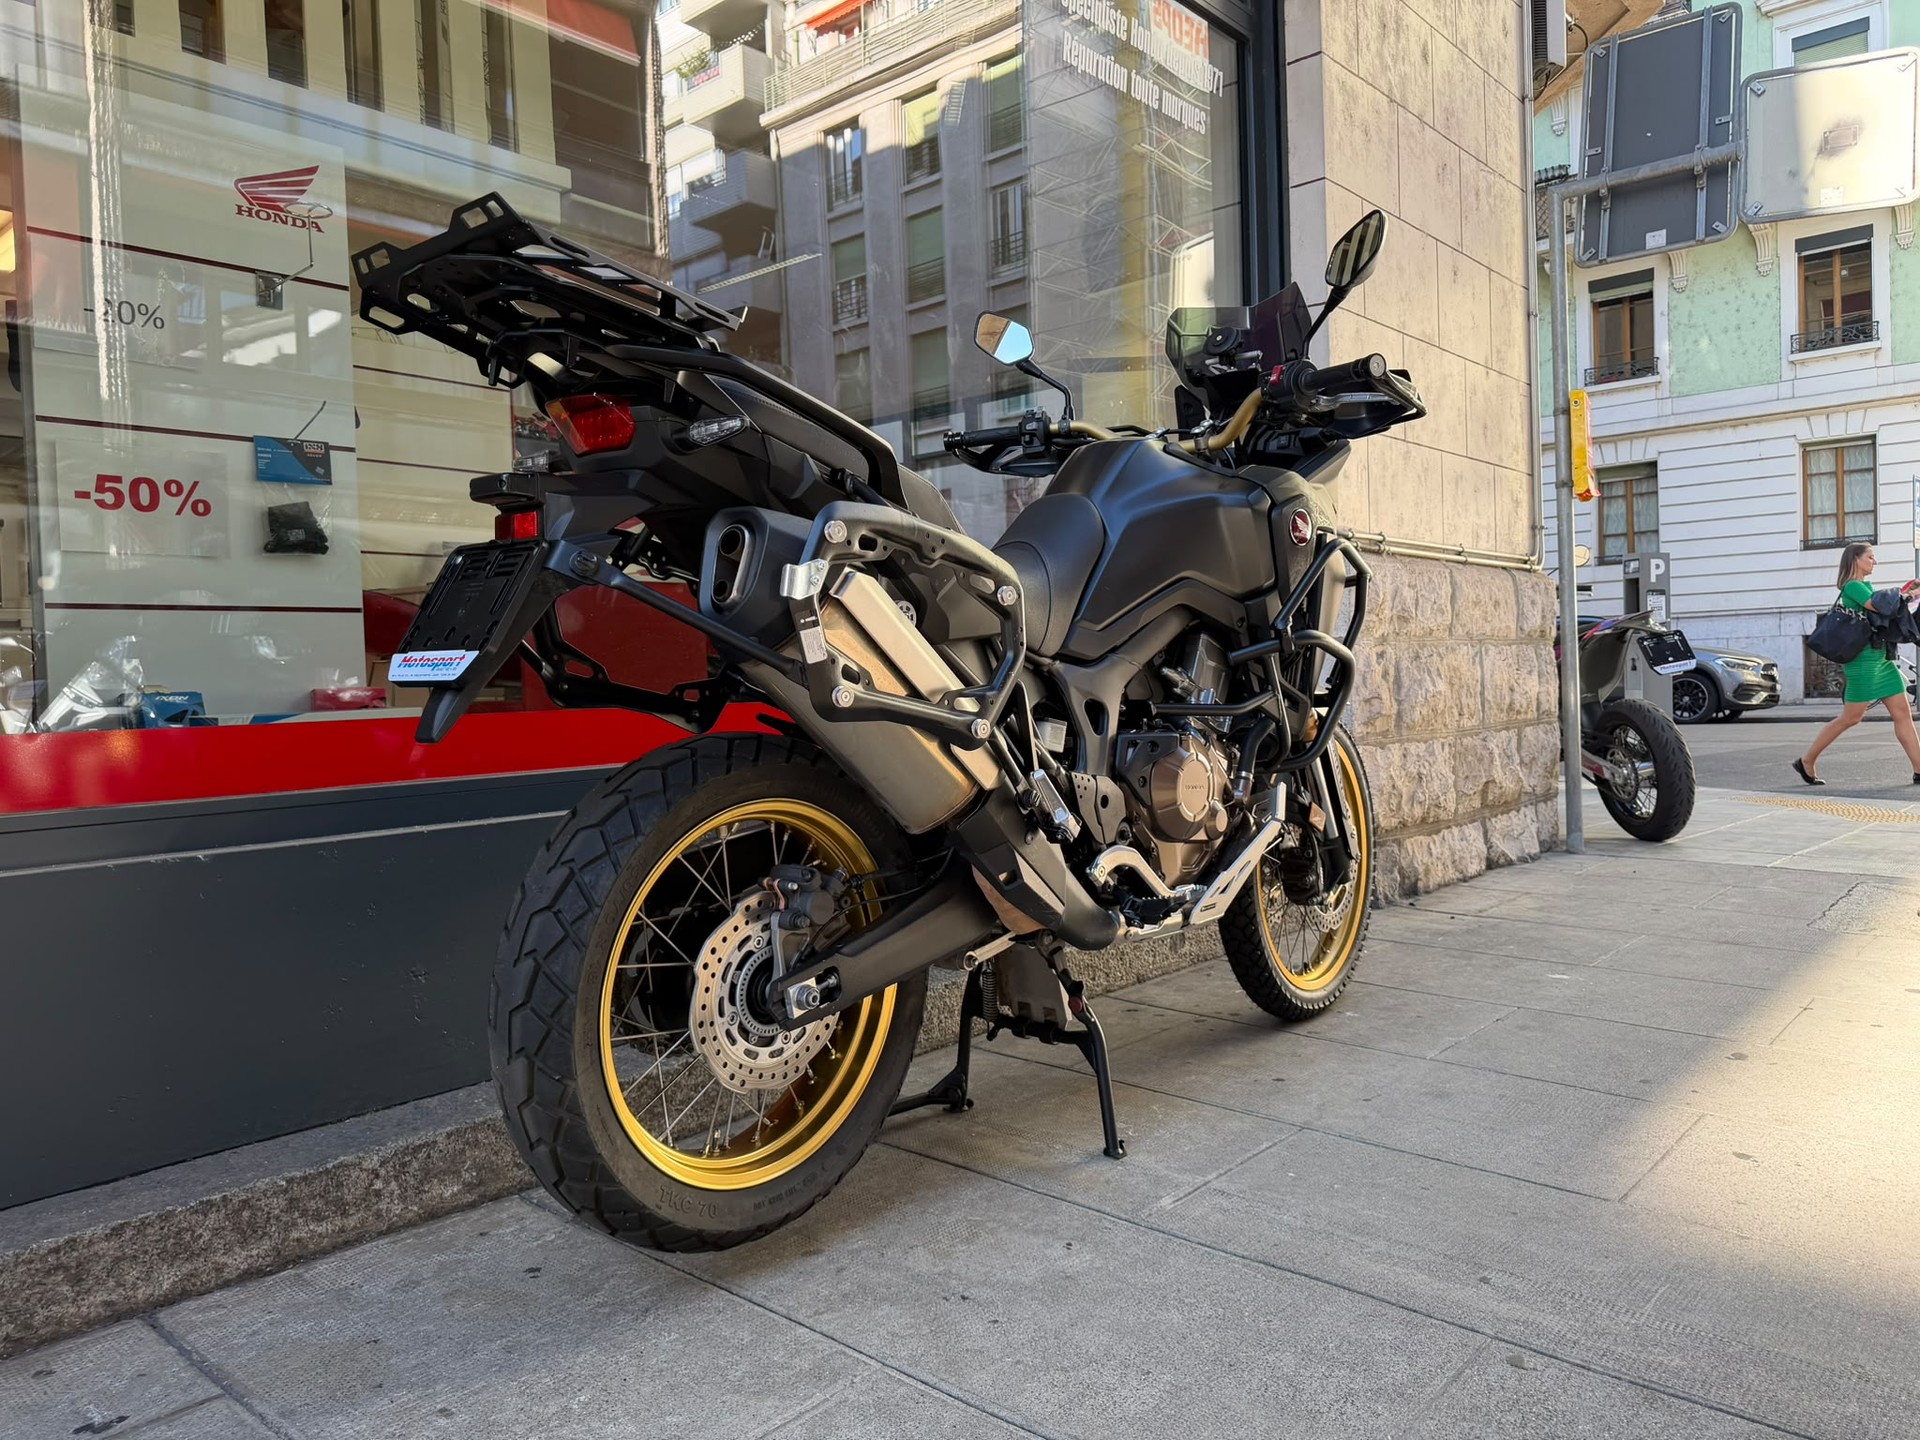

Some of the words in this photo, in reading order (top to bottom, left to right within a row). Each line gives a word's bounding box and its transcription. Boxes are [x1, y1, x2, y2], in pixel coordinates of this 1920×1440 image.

[1061, 0, 1128, 41] pcialiste
[1203, 61, 1224, 97] 1971
[1063, 30, 1128, 93] Réparation
[1130, 69, 1160, 109] toute
[1162, 89, 1206, 135] marques
[235, 203, 325, 233] HONDA
[74, 473, 212, 517] -50%
[1650, 558, 1665, 583] P
[397, 654, 466, 671] Motosport
[660, 1185, 692, 1214] TKC
[697, 1199, 718, 1219] 70
